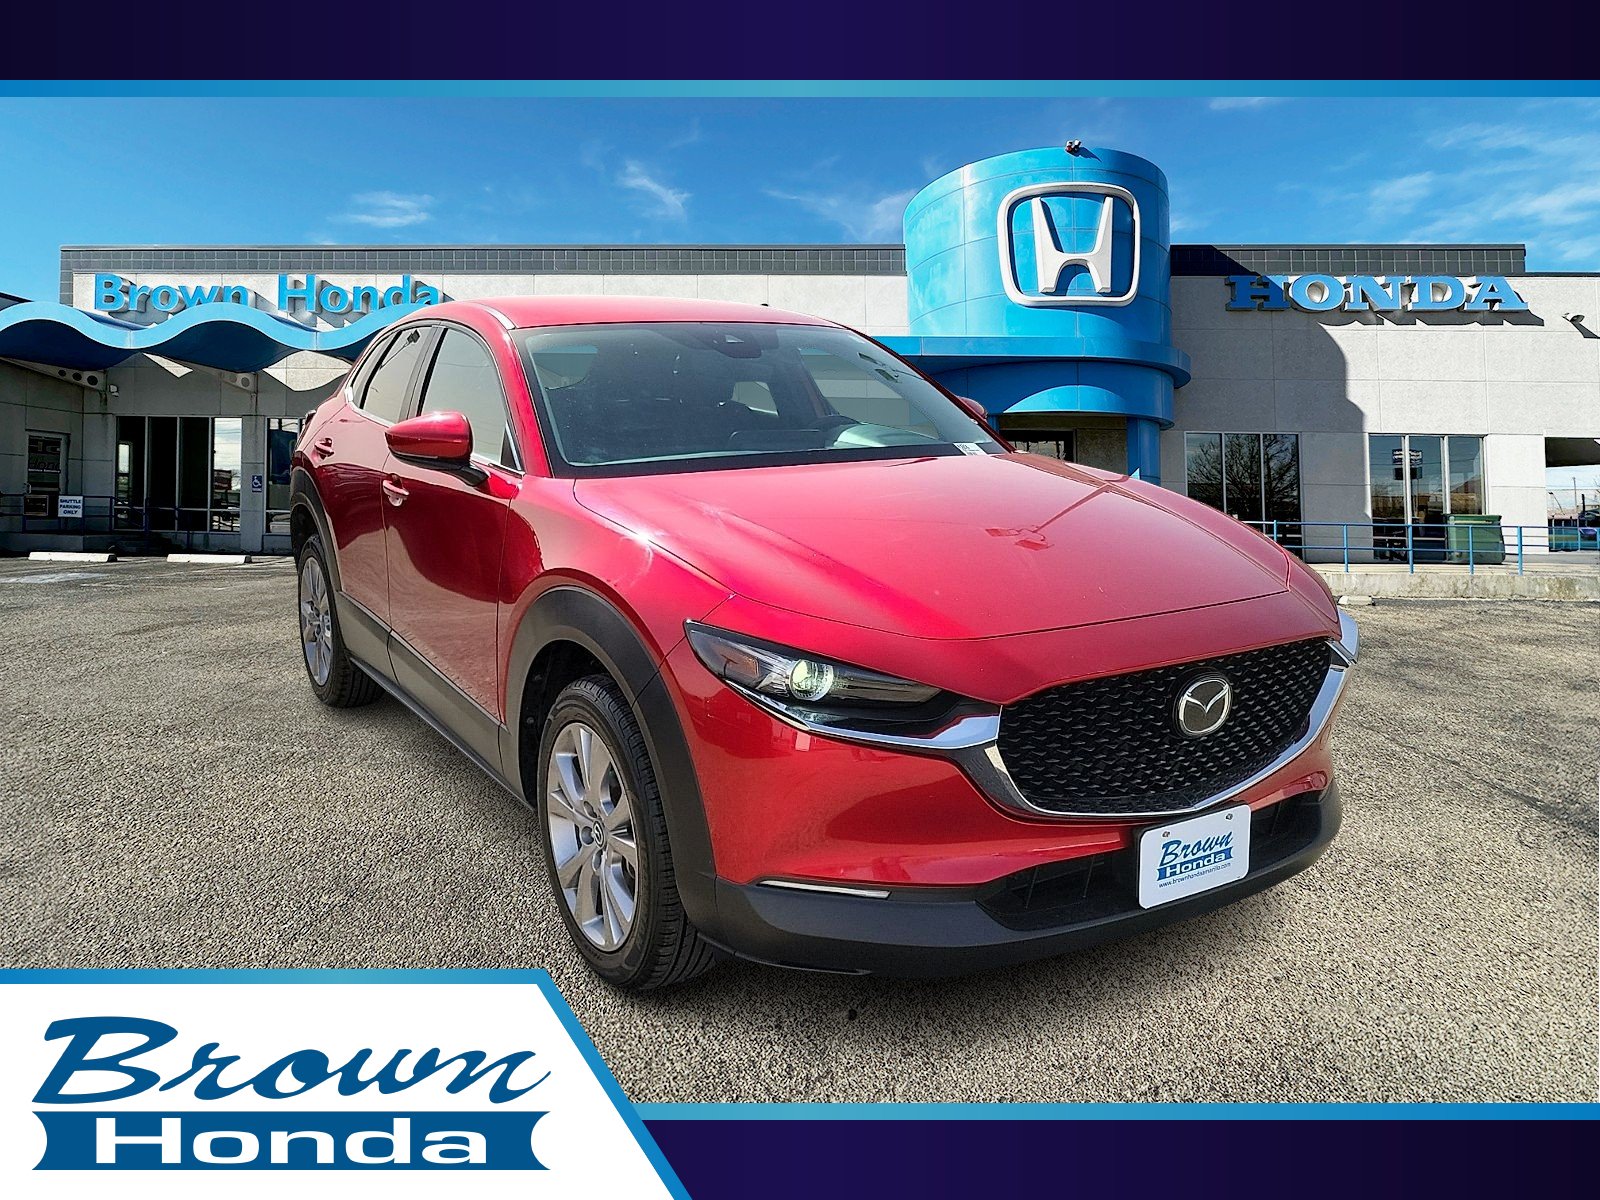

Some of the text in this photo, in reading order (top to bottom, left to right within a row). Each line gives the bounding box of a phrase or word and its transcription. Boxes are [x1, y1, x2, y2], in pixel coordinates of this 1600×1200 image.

[94, 273, 440, 313] Brown Honda
[1227, 274, 1528, 312] HONDA
[1159, 831, 1234, 867] Brown
[1166, 851, 1226, 877] Honda
